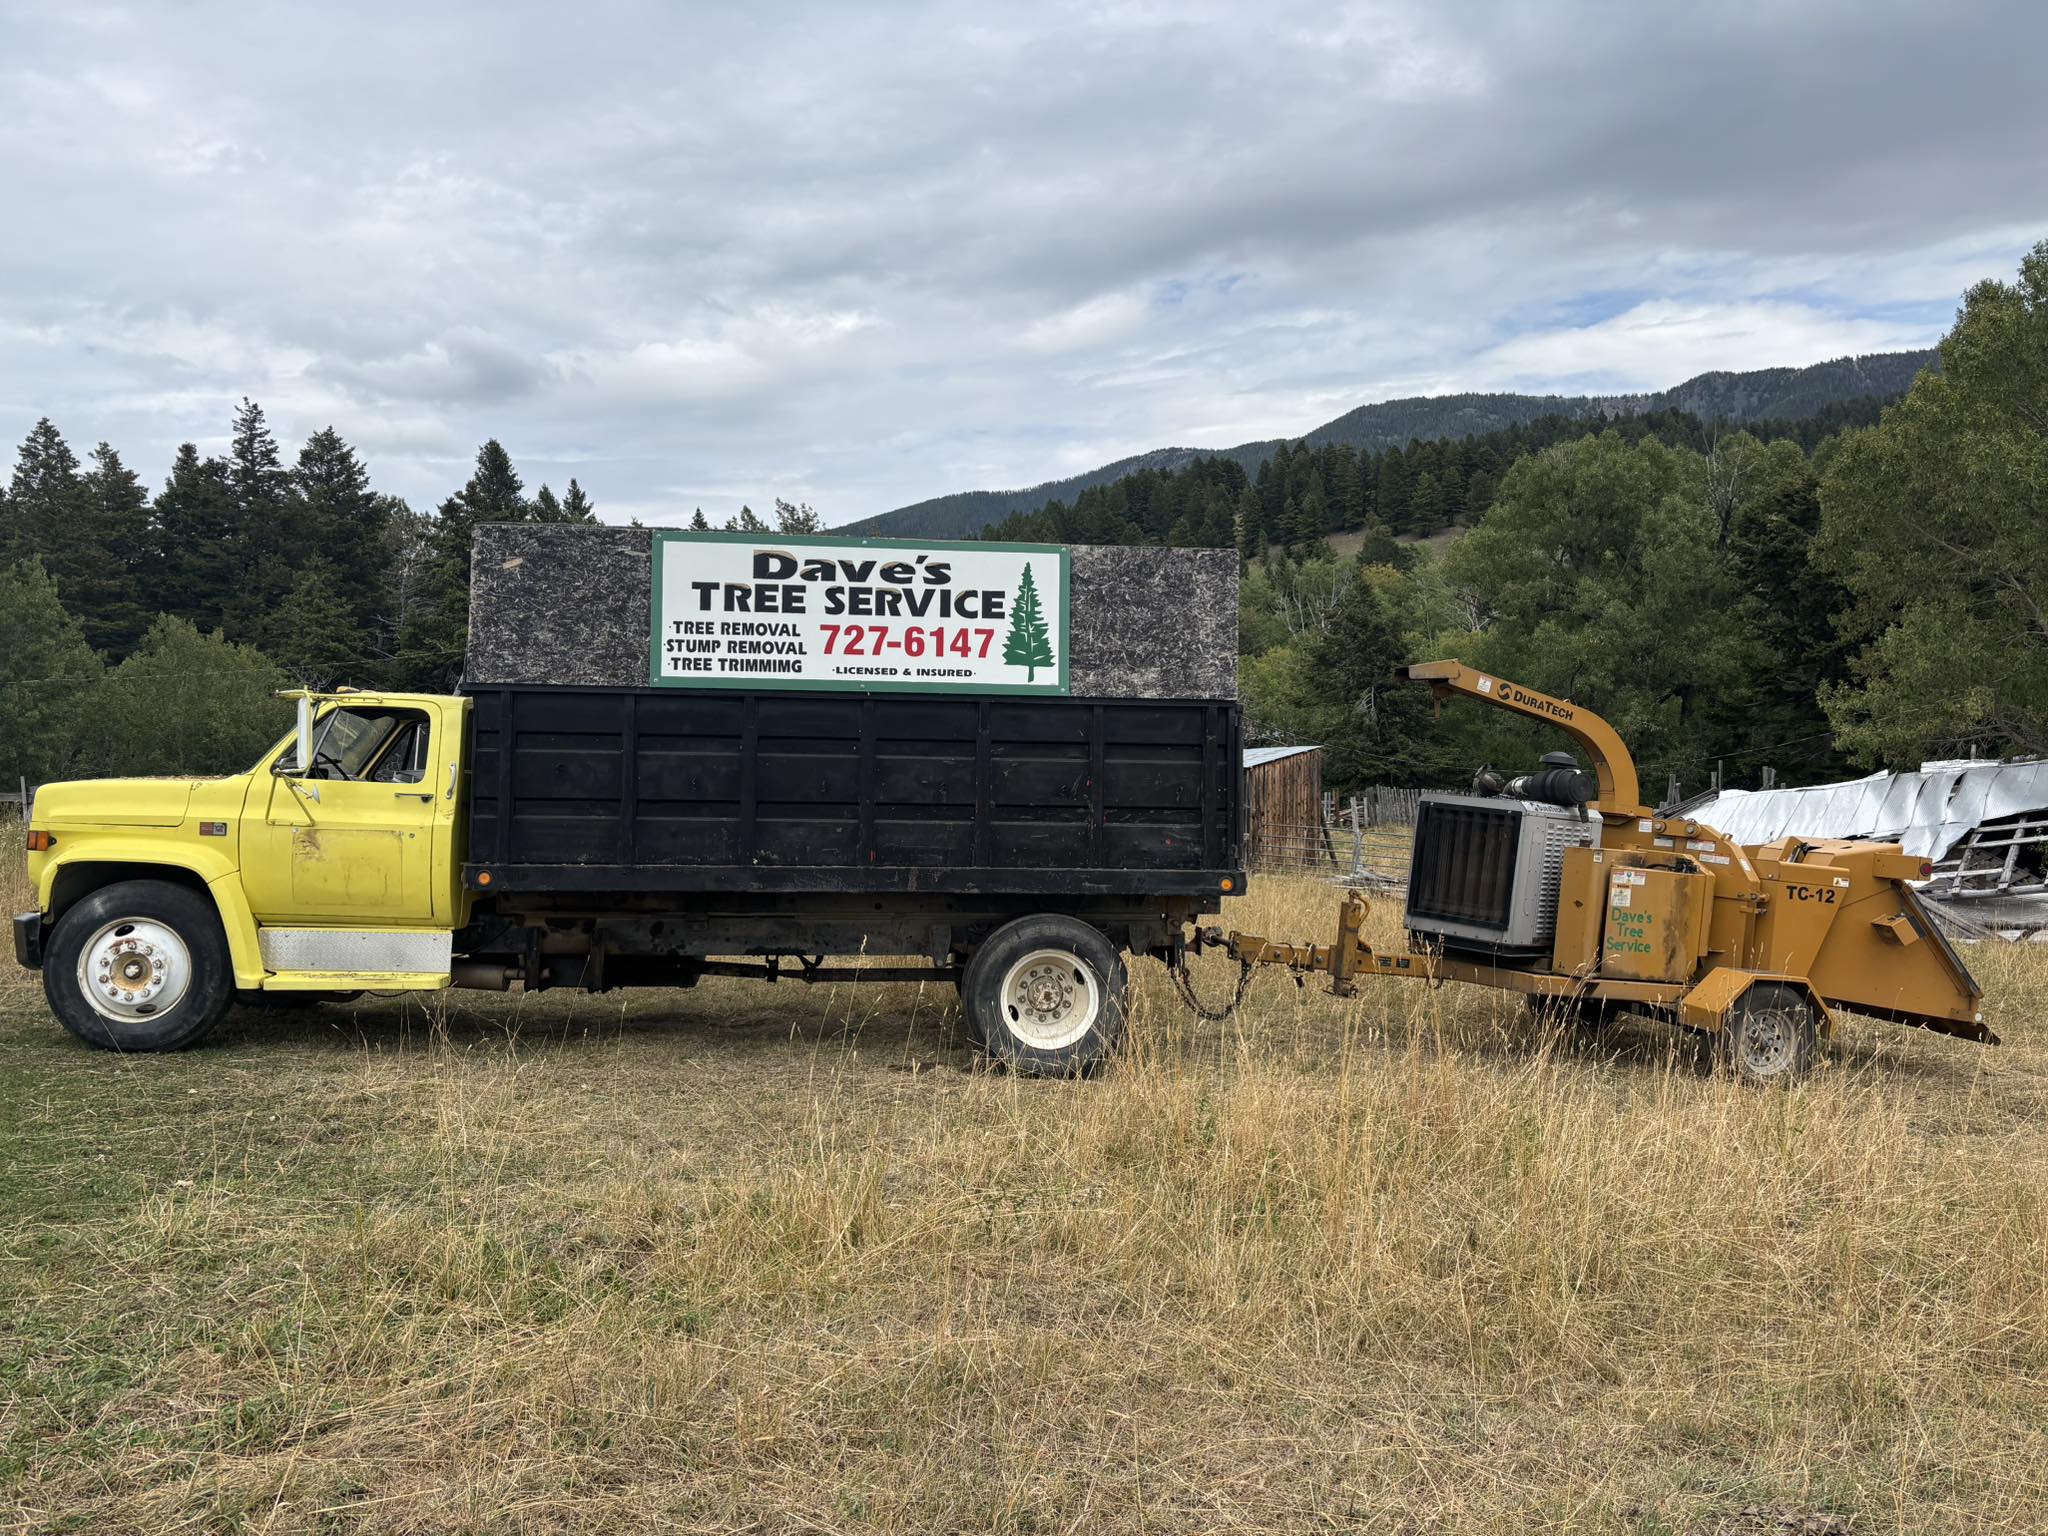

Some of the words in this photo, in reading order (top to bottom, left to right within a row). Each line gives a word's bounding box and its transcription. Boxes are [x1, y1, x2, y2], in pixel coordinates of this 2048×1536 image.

[753, 549, 951, 584] Dave's
[692, 582, 806, 613] TREE
[824, 586, 1005, 619] SERVICE
[673, 621, 715, 635] TREE
[721, 622, 801, 637] REMOVAL
[666, 639, 721, 653] STUMP
[727, 641, 807, 655] REMOVAL
[820, 624, 995, 658] 727-6147
[671, 658, 713, 671] TREE
[836, 666, 898, 675] LICENSED
[903, 668, 912, 676] &
[917, 668, 972, 677] INSURED
[1786, 885, 1836, 904] TC-12
[1611, 907, 1653, 924] Dave's
[1617, 922, 1644, 938] Tree
[1607, 936, 1652, 953] Service
